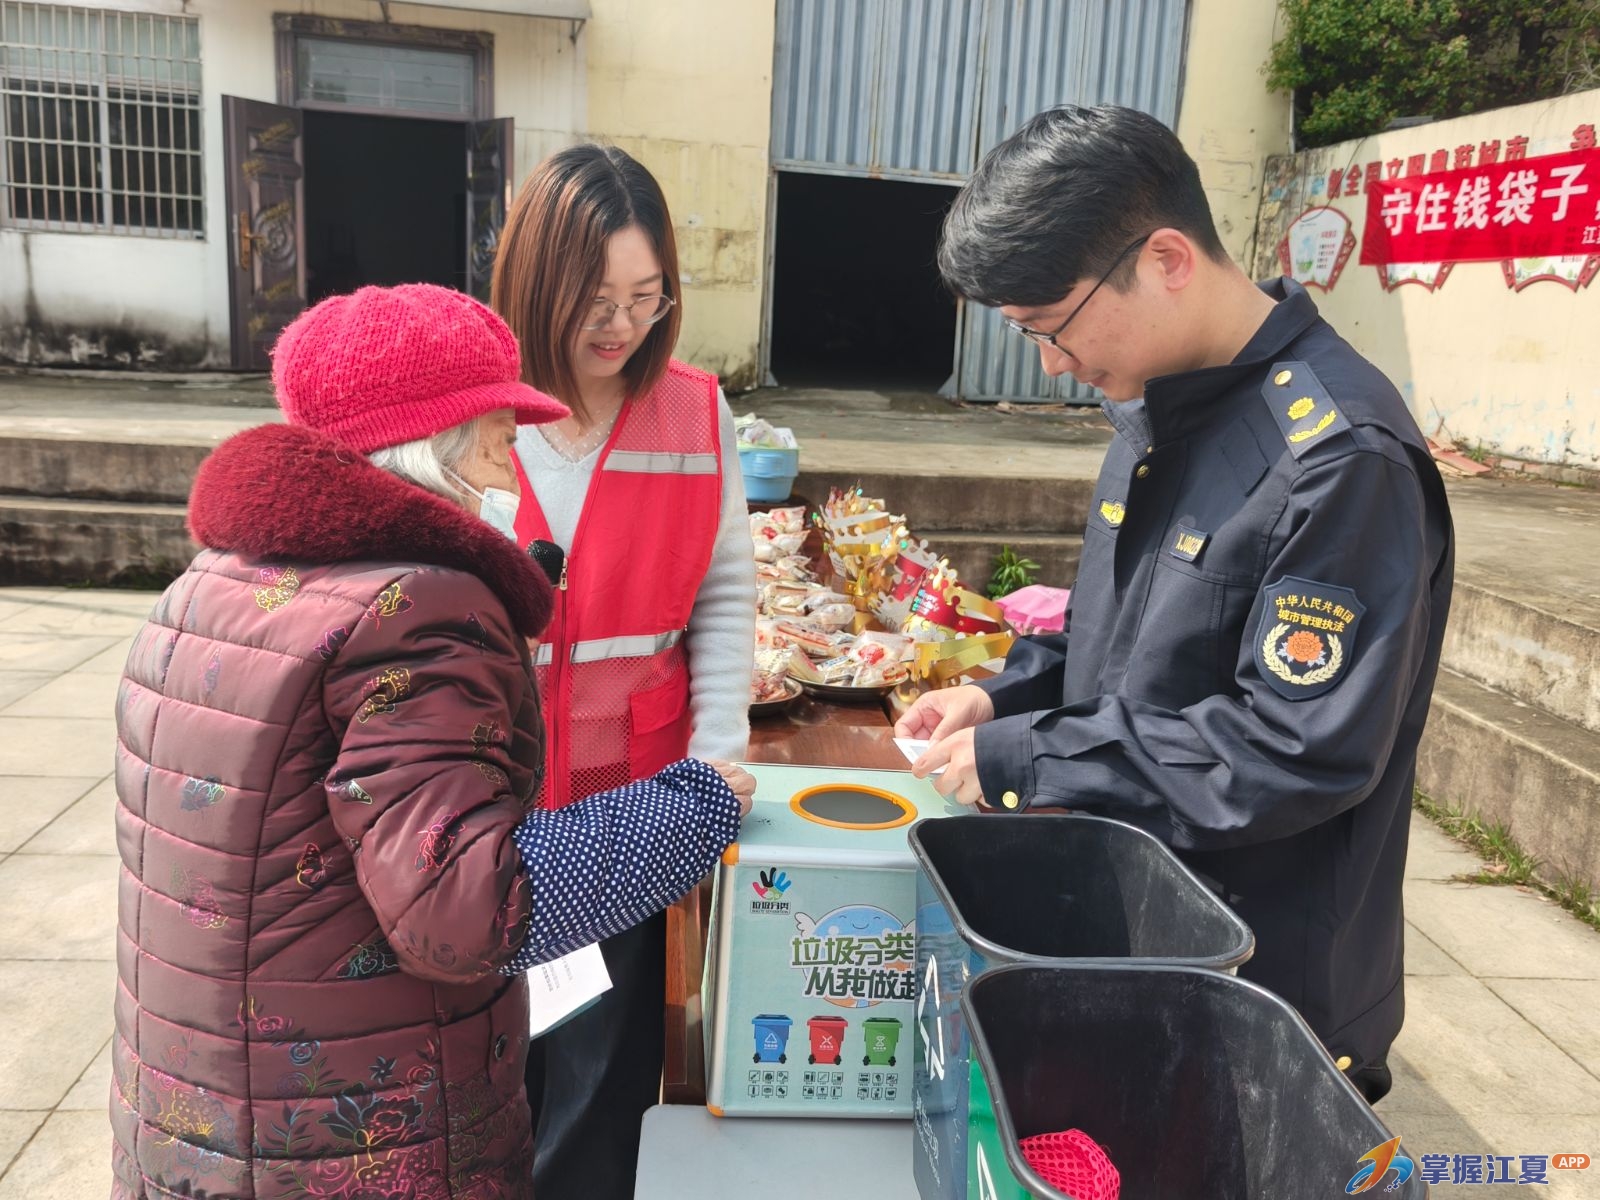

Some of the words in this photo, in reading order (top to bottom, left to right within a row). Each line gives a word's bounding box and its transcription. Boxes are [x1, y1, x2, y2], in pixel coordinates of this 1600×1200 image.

[1380, 163, 1589, 236] 守住钱袋子
[1275, 594, 1354, 624] 中华人民共和国
[1277, 608, 1345, 632] 城市管理执法
[792, 933, 914, 966] 垃圾分类
